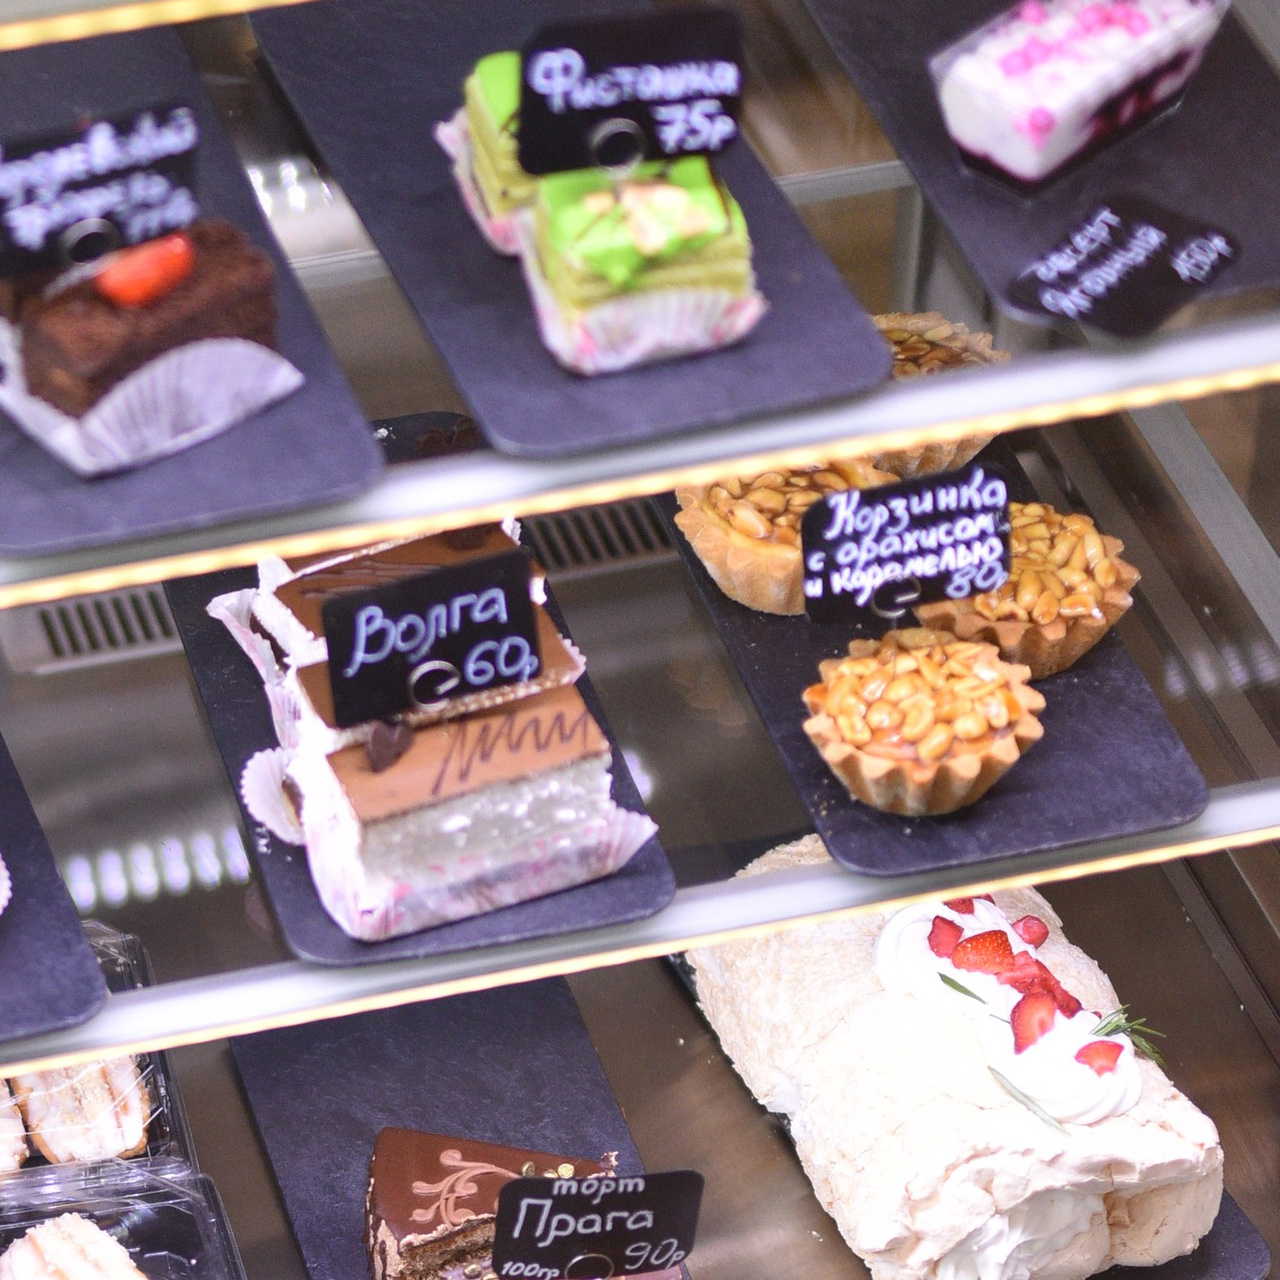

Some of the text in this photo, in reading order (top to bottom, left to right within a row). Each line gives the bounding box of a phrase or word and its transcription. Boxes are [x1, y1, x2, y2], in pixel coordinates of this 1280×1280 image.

[527, 47, 740, 114] Фисташка
[652, 98, 737, 153] 75р
[824, 465, 1008, 541] Корзинка
[804, 536, 1005, 606] и карамелью
[807, 551, 827, 571] с
[343, 587, 508, 678] Волга
[464, 635, 539, 684] 60р
[552, 1176, 646, 1205] торт
[513, 1197, 655, 1248] Прага
[501, 1238, 686, 1280] 100гр 90р
